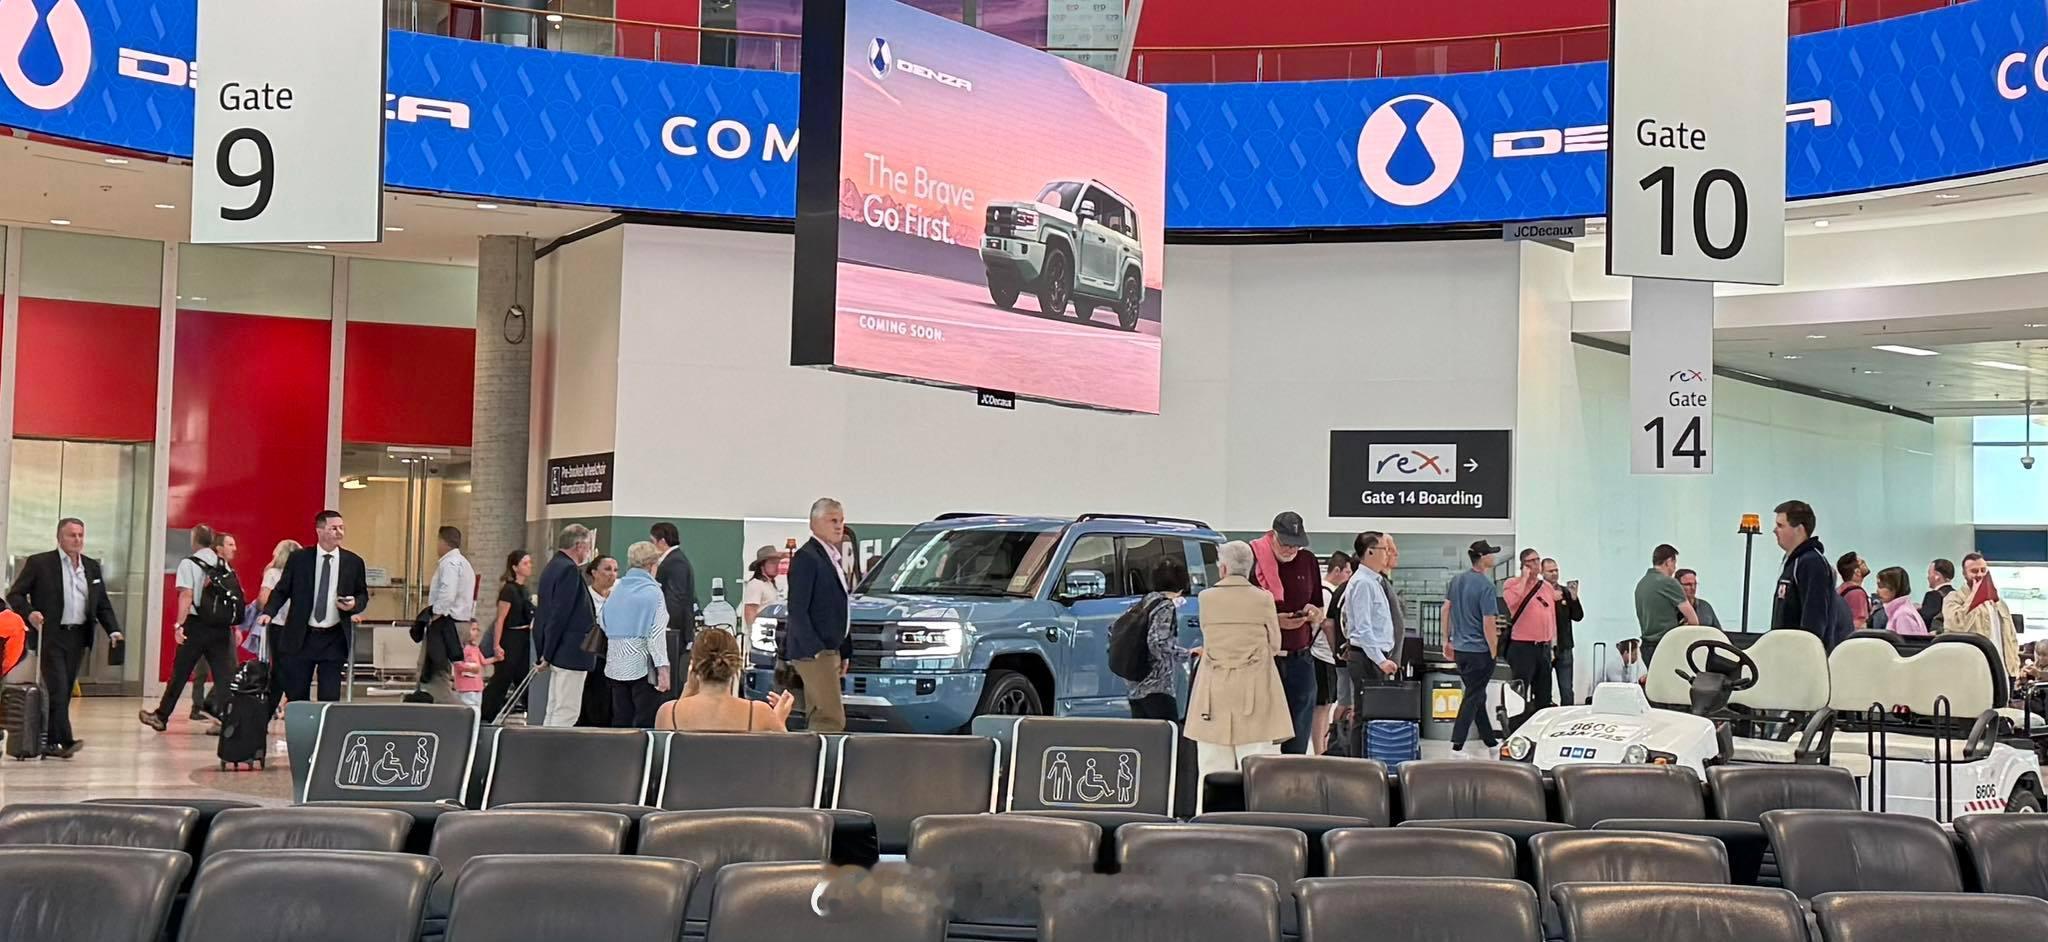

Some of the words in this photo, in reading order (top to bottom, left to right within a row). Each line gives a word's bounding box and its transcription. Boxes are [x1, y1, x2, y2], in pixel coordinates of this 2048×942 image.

[897, 59, 972, 92] DENZA
[219, 82, 293, 111] Gate
[661, 116, 800, 162] COM
[1636, 119, 1706, 150] Gate
[216, 127, 275, 221] 9
[863, 152, 908, 194] The
[914, 165, 976, 210] Brave
[863, 194, 899, 231] Go
[905, 203, 956, 245] First.
[1639, 166, 1748, 259] 10
[1514, 225, 1574, 238] JCDecaux
[859, 315, 907, 334] COMING
[911, 324, 946, 341] SOON.
[1669, 391, 1707, 407] Gate
[1643, 416, 1707, 469] 14
[1361, 490, 1395, 505] Gate
[1398, 490, 1415, 504] 14
[1418, 490, 1483, 509] Boarding
[1975, 783, 1997, 799] 8606
